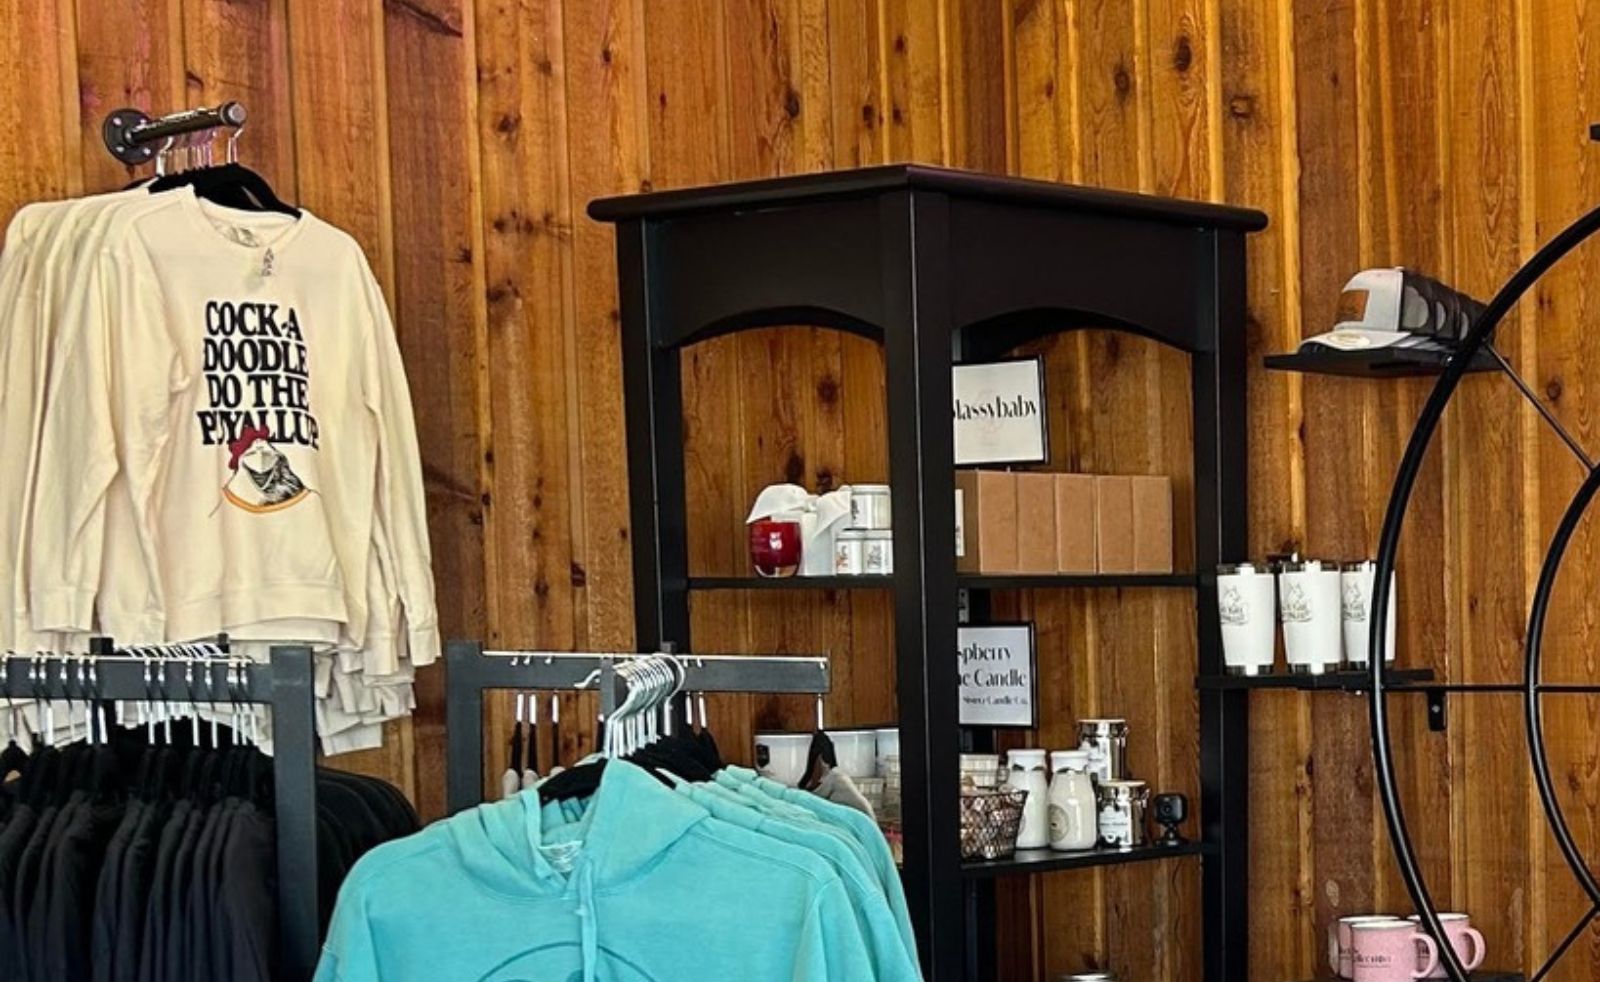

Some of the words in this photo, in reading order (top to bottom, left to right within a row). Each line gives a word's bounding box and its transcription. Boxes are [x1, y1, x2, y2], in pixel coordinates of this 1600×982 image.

[203, 338, 309, 378] DOODLE
[206, 374, 242, 408] DO
[247, 375, 310, 411] THE
[956, 394, 1036, 420] lassybaby
[974, 669, 1026, 687] Candle
